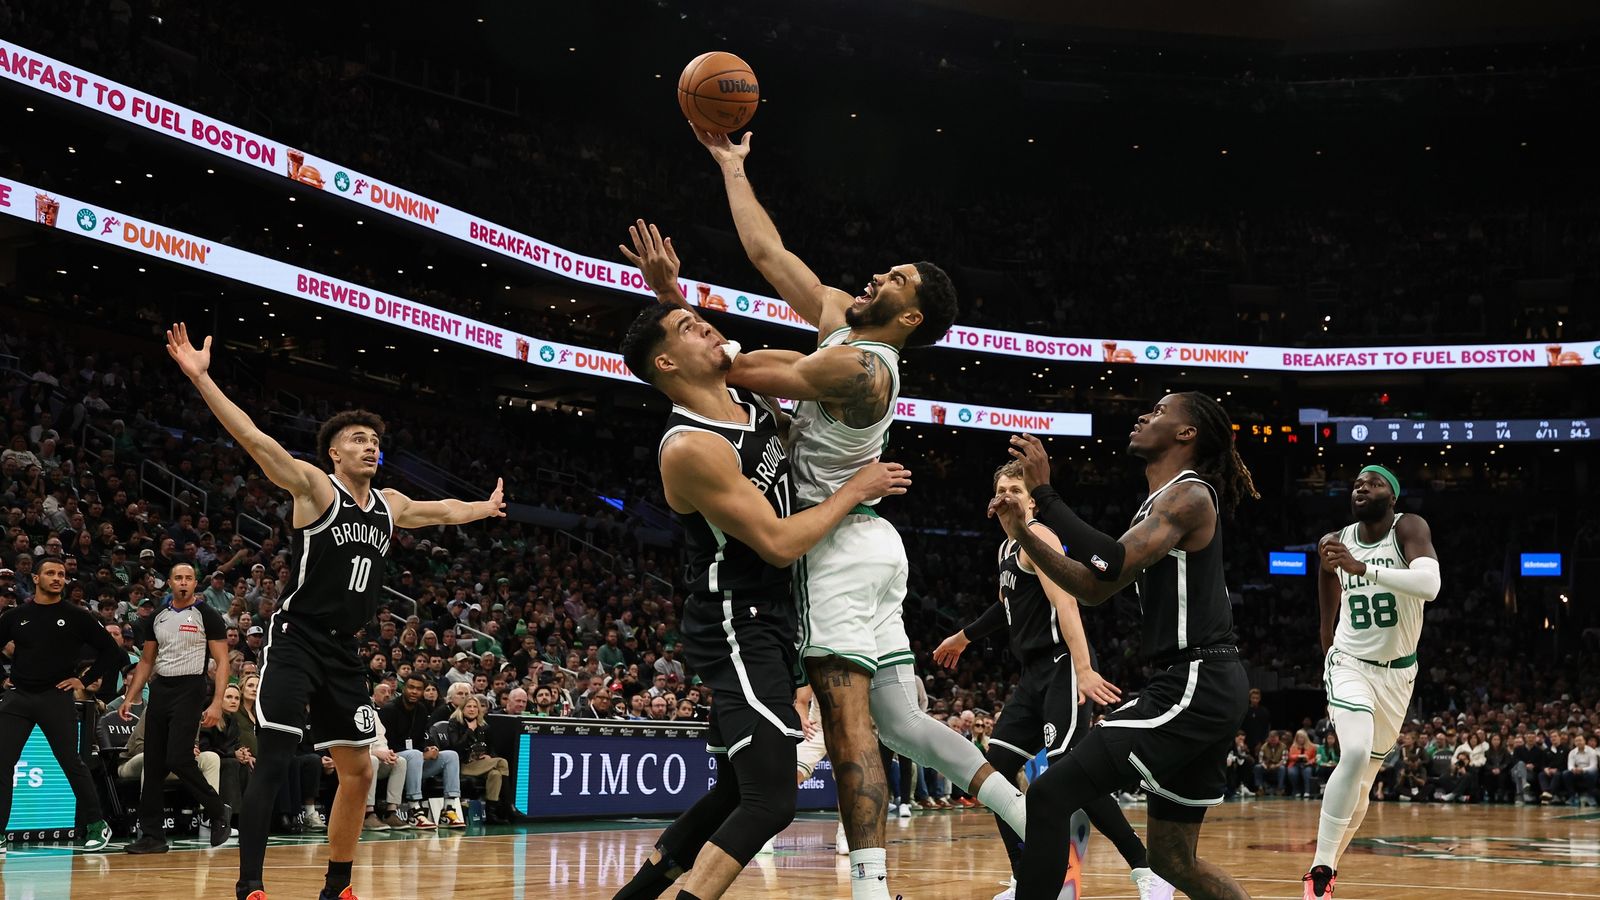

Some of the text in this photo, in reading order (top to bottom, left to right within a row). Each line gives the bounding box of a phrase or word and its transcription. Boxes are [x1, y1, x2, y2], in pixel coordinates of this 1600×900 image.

[93, 82, 126, 111] TO
[132, 97, 186, 135] FUEL
[192, 119, 276, 167] BOSTON
[371, 184, 439, 224] DUNKIN'
[123, 222, 211, 264] DUNKIN'
[470, 221, 550, 264] BREAKFAST
[553, 252, 572, 272] TO
[576, 260, 616, 284] FUEL
[297, 273, 503, 349] BREWED DIFFERENT HERE
[957, 331, 979, 346] TO
[983, 334, 1021, 351] FUEL
[1025, 339, 1092, 357] BOSTON
[1180, 348, 1249, 363] DUNKIN'
[1282, 349, 1535, 367] BREAKFAST TO FUEL BOSTON
[990, 412, 1054, 430] DUNKIN'
[1416, 431, 1423, 440] 4
[1442, 431, 1449, 440] 2
[1466, 430, 1473, 439] 3
[1496, 430, 1511, 439] 1/4
[1536, 429, 1558, 439] 6/11
[1570, 428, 1590, 438] 54.5
[331, 522, 391, 557] BROOKLYN
[348, 555, 372, 593] 10
[1348, 592, 1399, 630] 88
[550, 752, 687, 796] PIMCO
